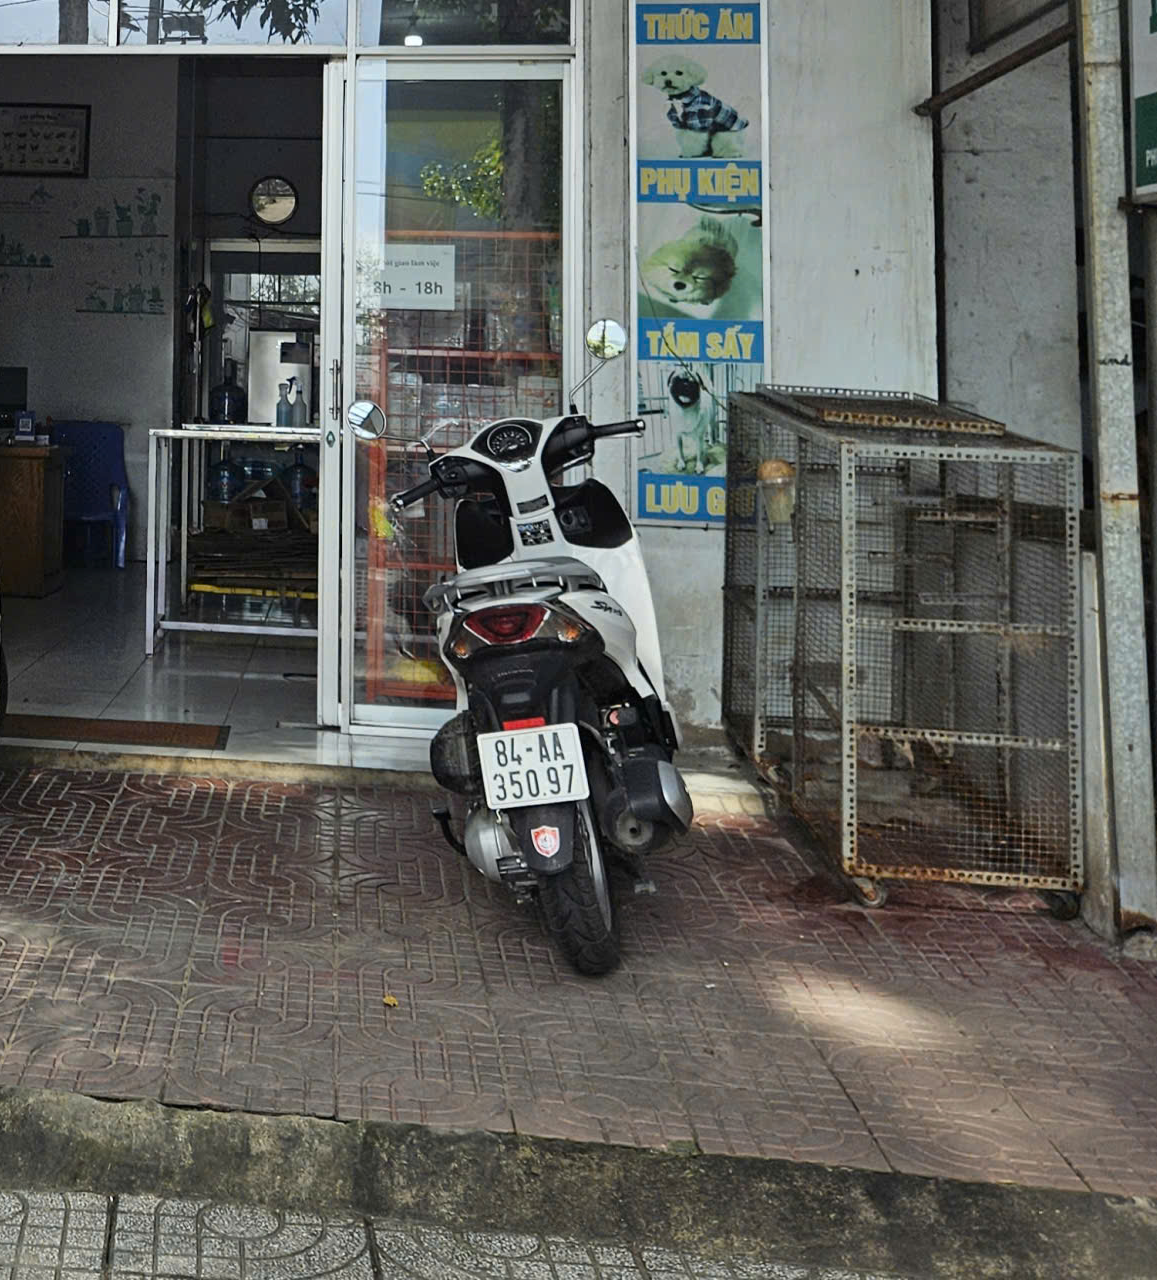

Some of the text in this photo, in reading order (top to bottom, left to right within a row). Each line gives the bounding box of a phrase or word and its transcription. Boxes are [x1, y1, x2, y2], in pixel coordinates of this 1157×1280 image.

[415, 280, 444, 295] 18h
[494, 732, 566, 768] 84-AA
[493, 764, 575, 802] 350.97
